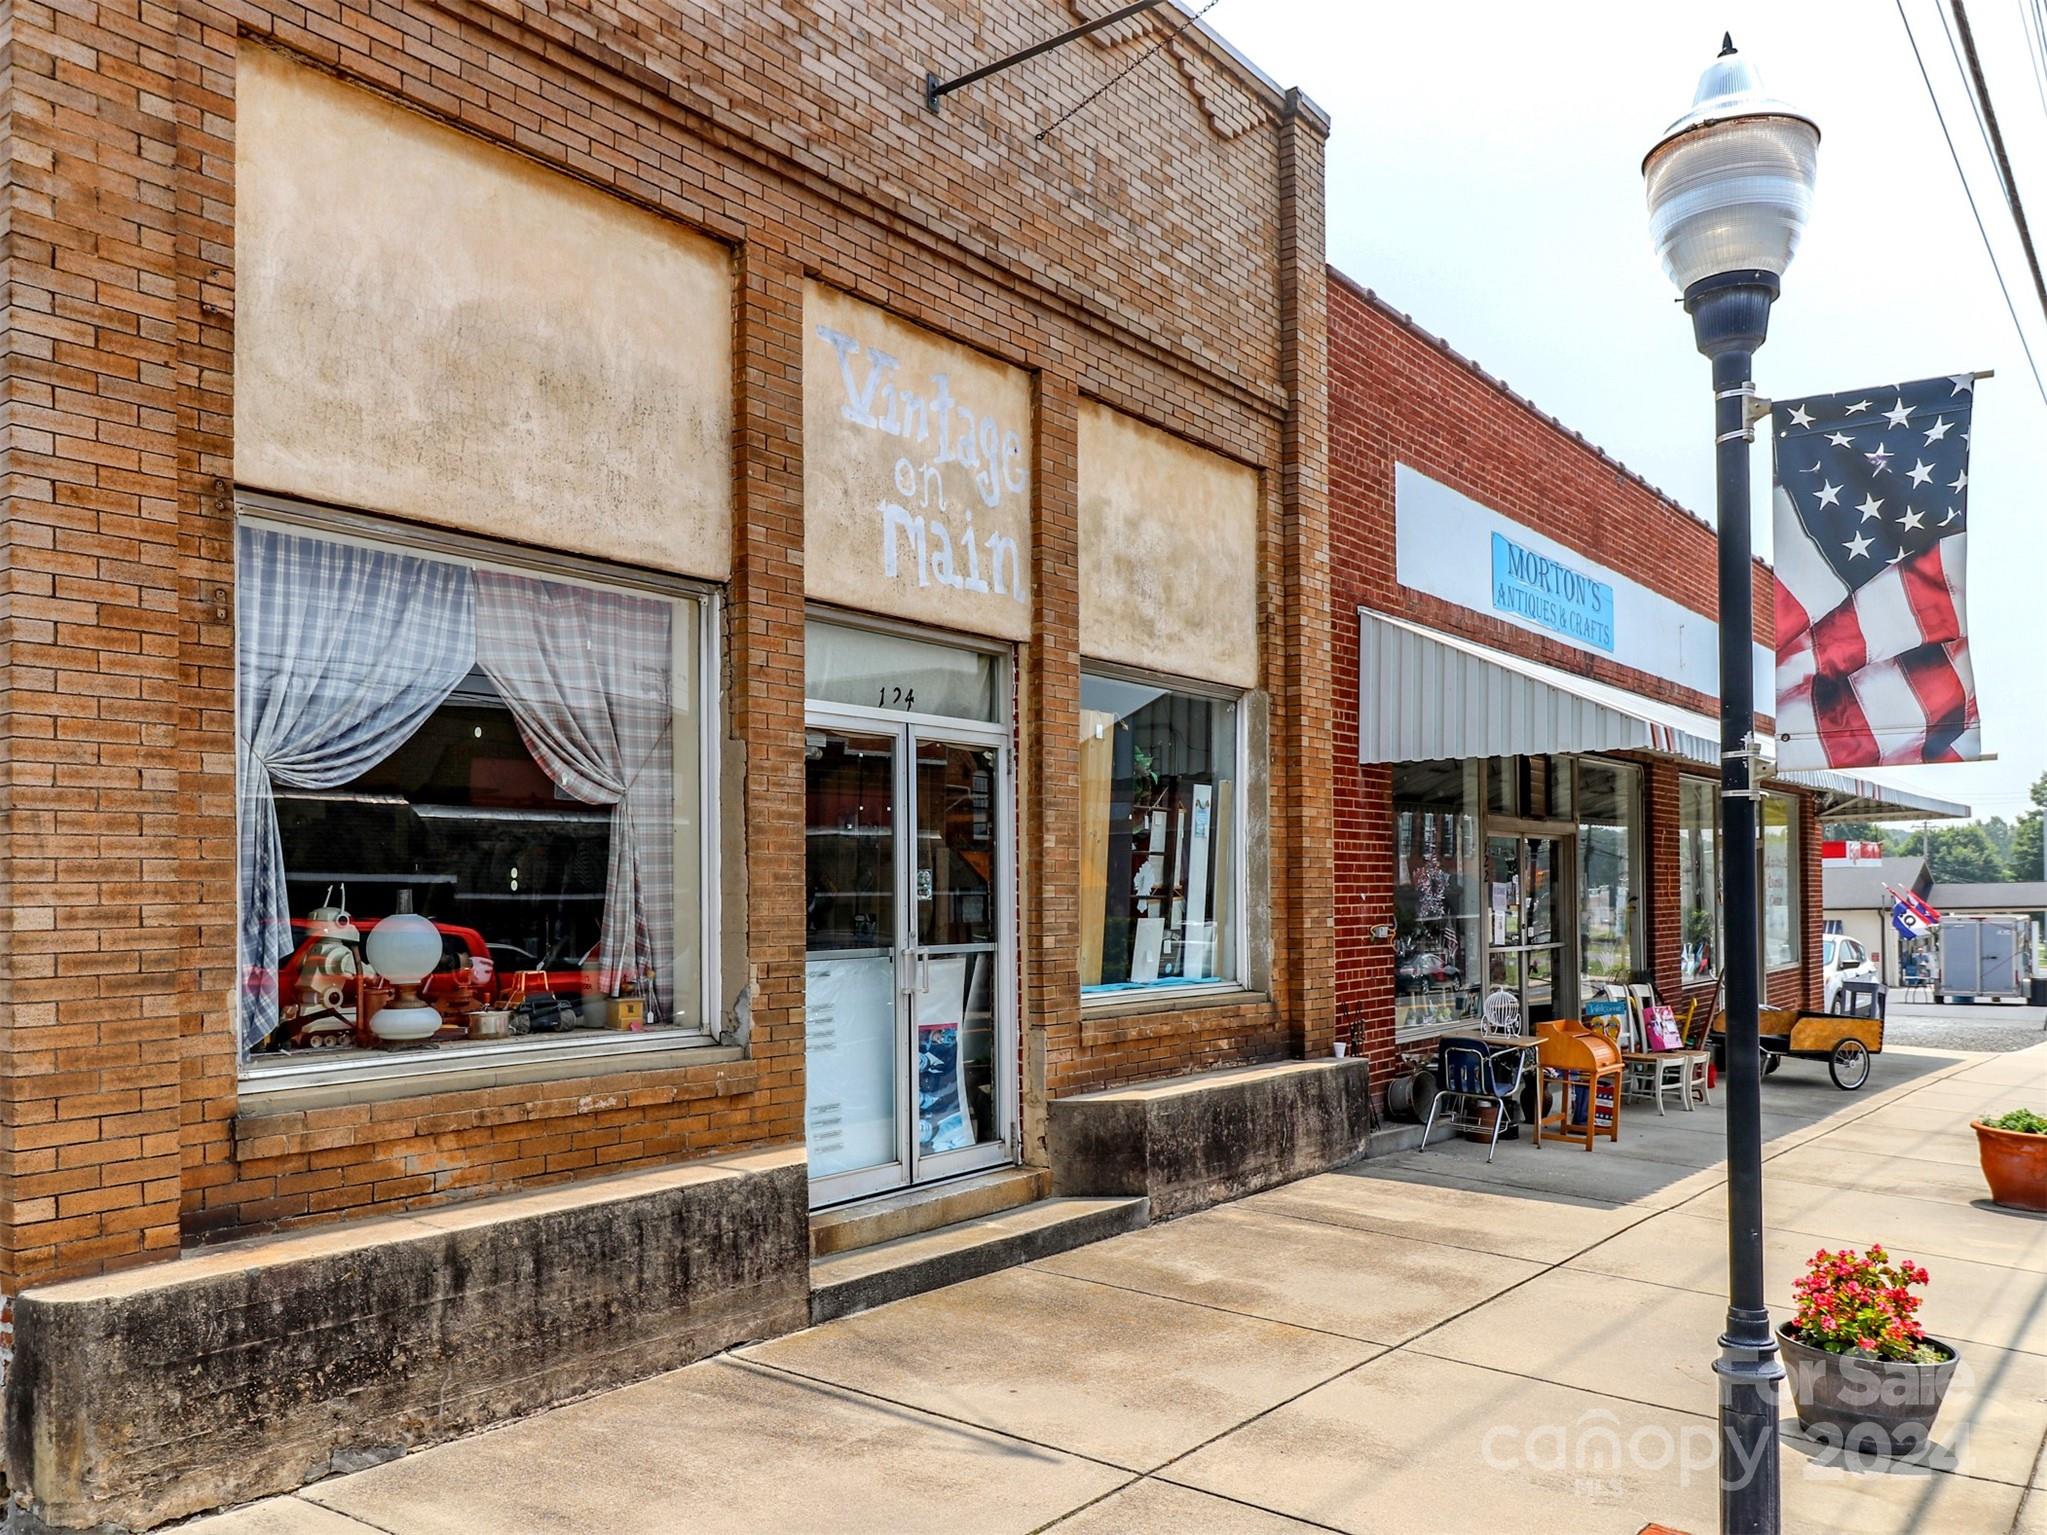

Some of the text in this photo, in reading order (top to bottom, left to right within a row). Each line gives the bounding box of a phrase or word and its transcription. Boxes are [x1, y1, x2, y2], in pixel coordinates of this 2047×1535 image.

[816, 324, 1026, 509] Vintage
[894, 458, 946, 511] on
[877, 499, 1025, 603] Main
[1508, 543, 1602, 612] MORTON'S
[1497, 583, 1611, 645] ANTIQUES & CRAFTS
